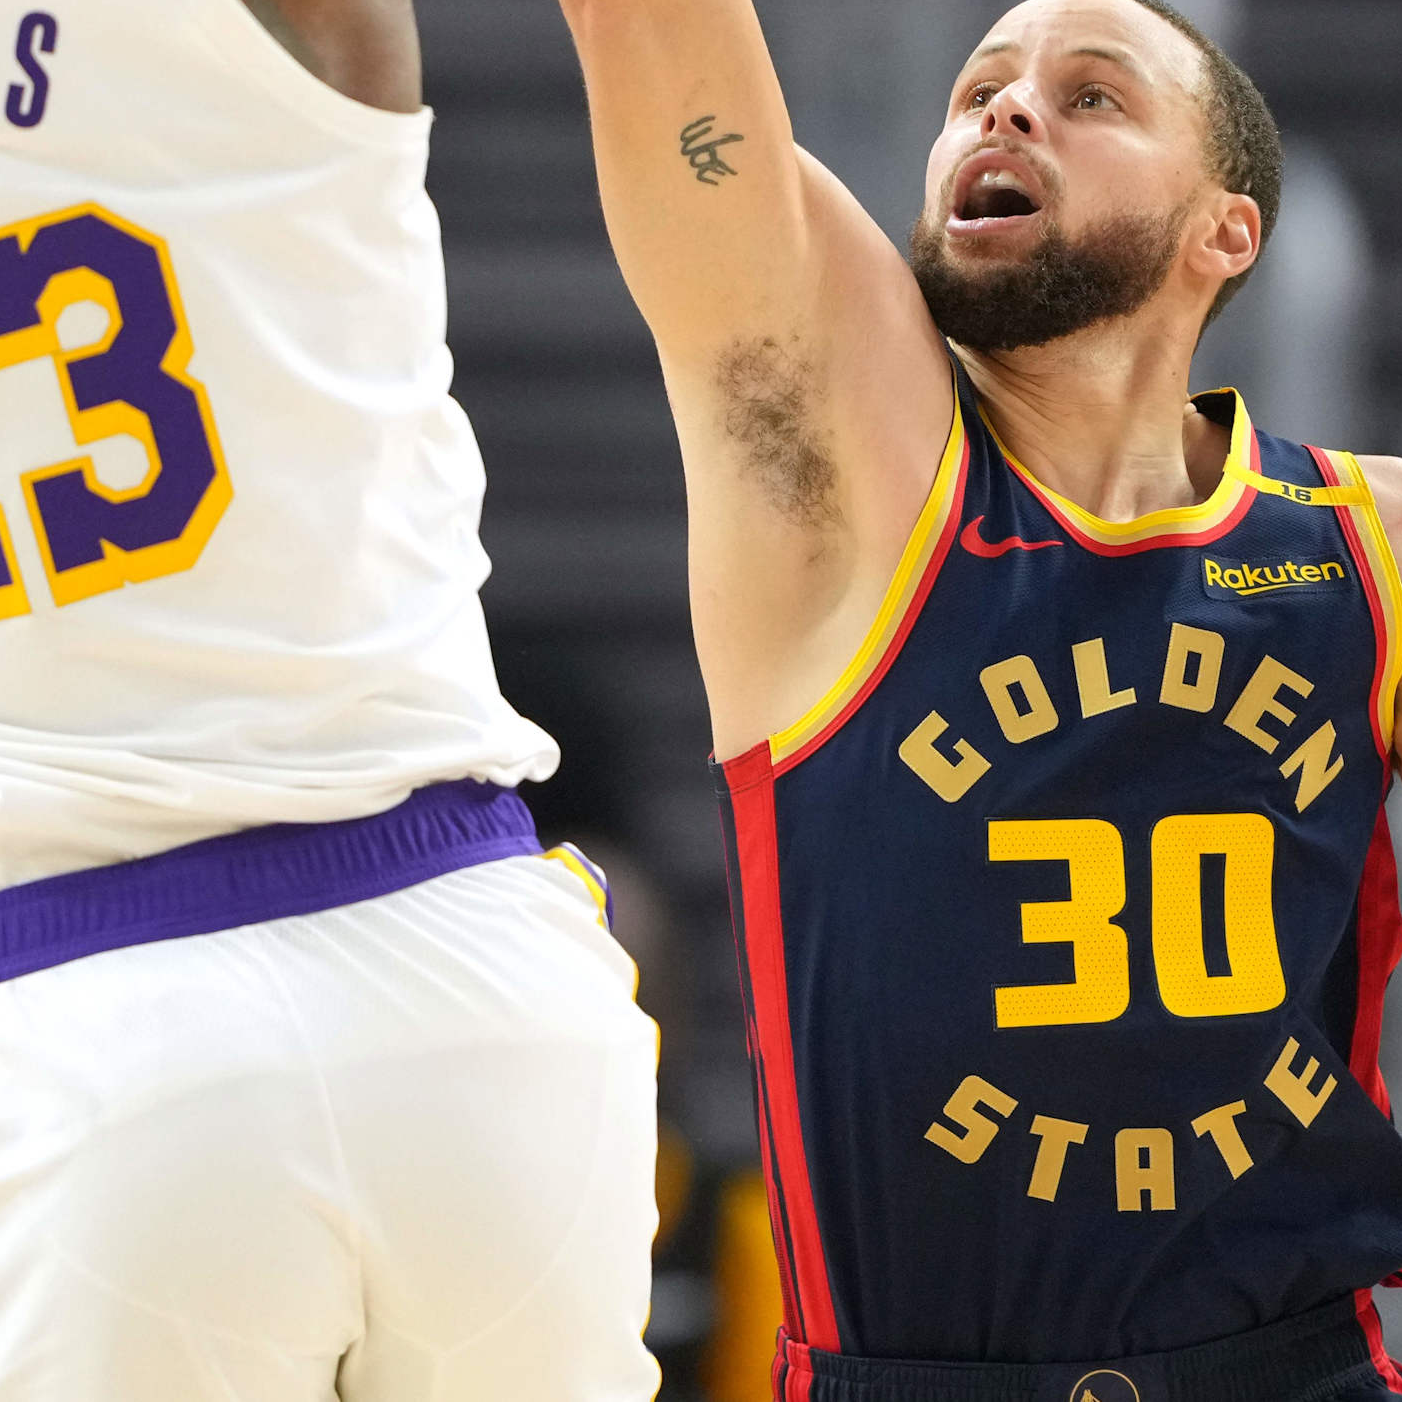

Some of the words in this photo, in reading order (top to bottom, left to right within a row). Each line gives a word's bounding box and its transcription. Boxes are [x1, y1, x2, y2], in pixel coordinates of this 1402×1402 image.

[1204, 558, 1345, 590] Rakuten
[1281, 484, 1312, 502] 16
[898, 622, 1345, 813] GOLDEN
[987, 812, 1287, 1029] 30
[923, 1036, 1338, 1212] STATE
